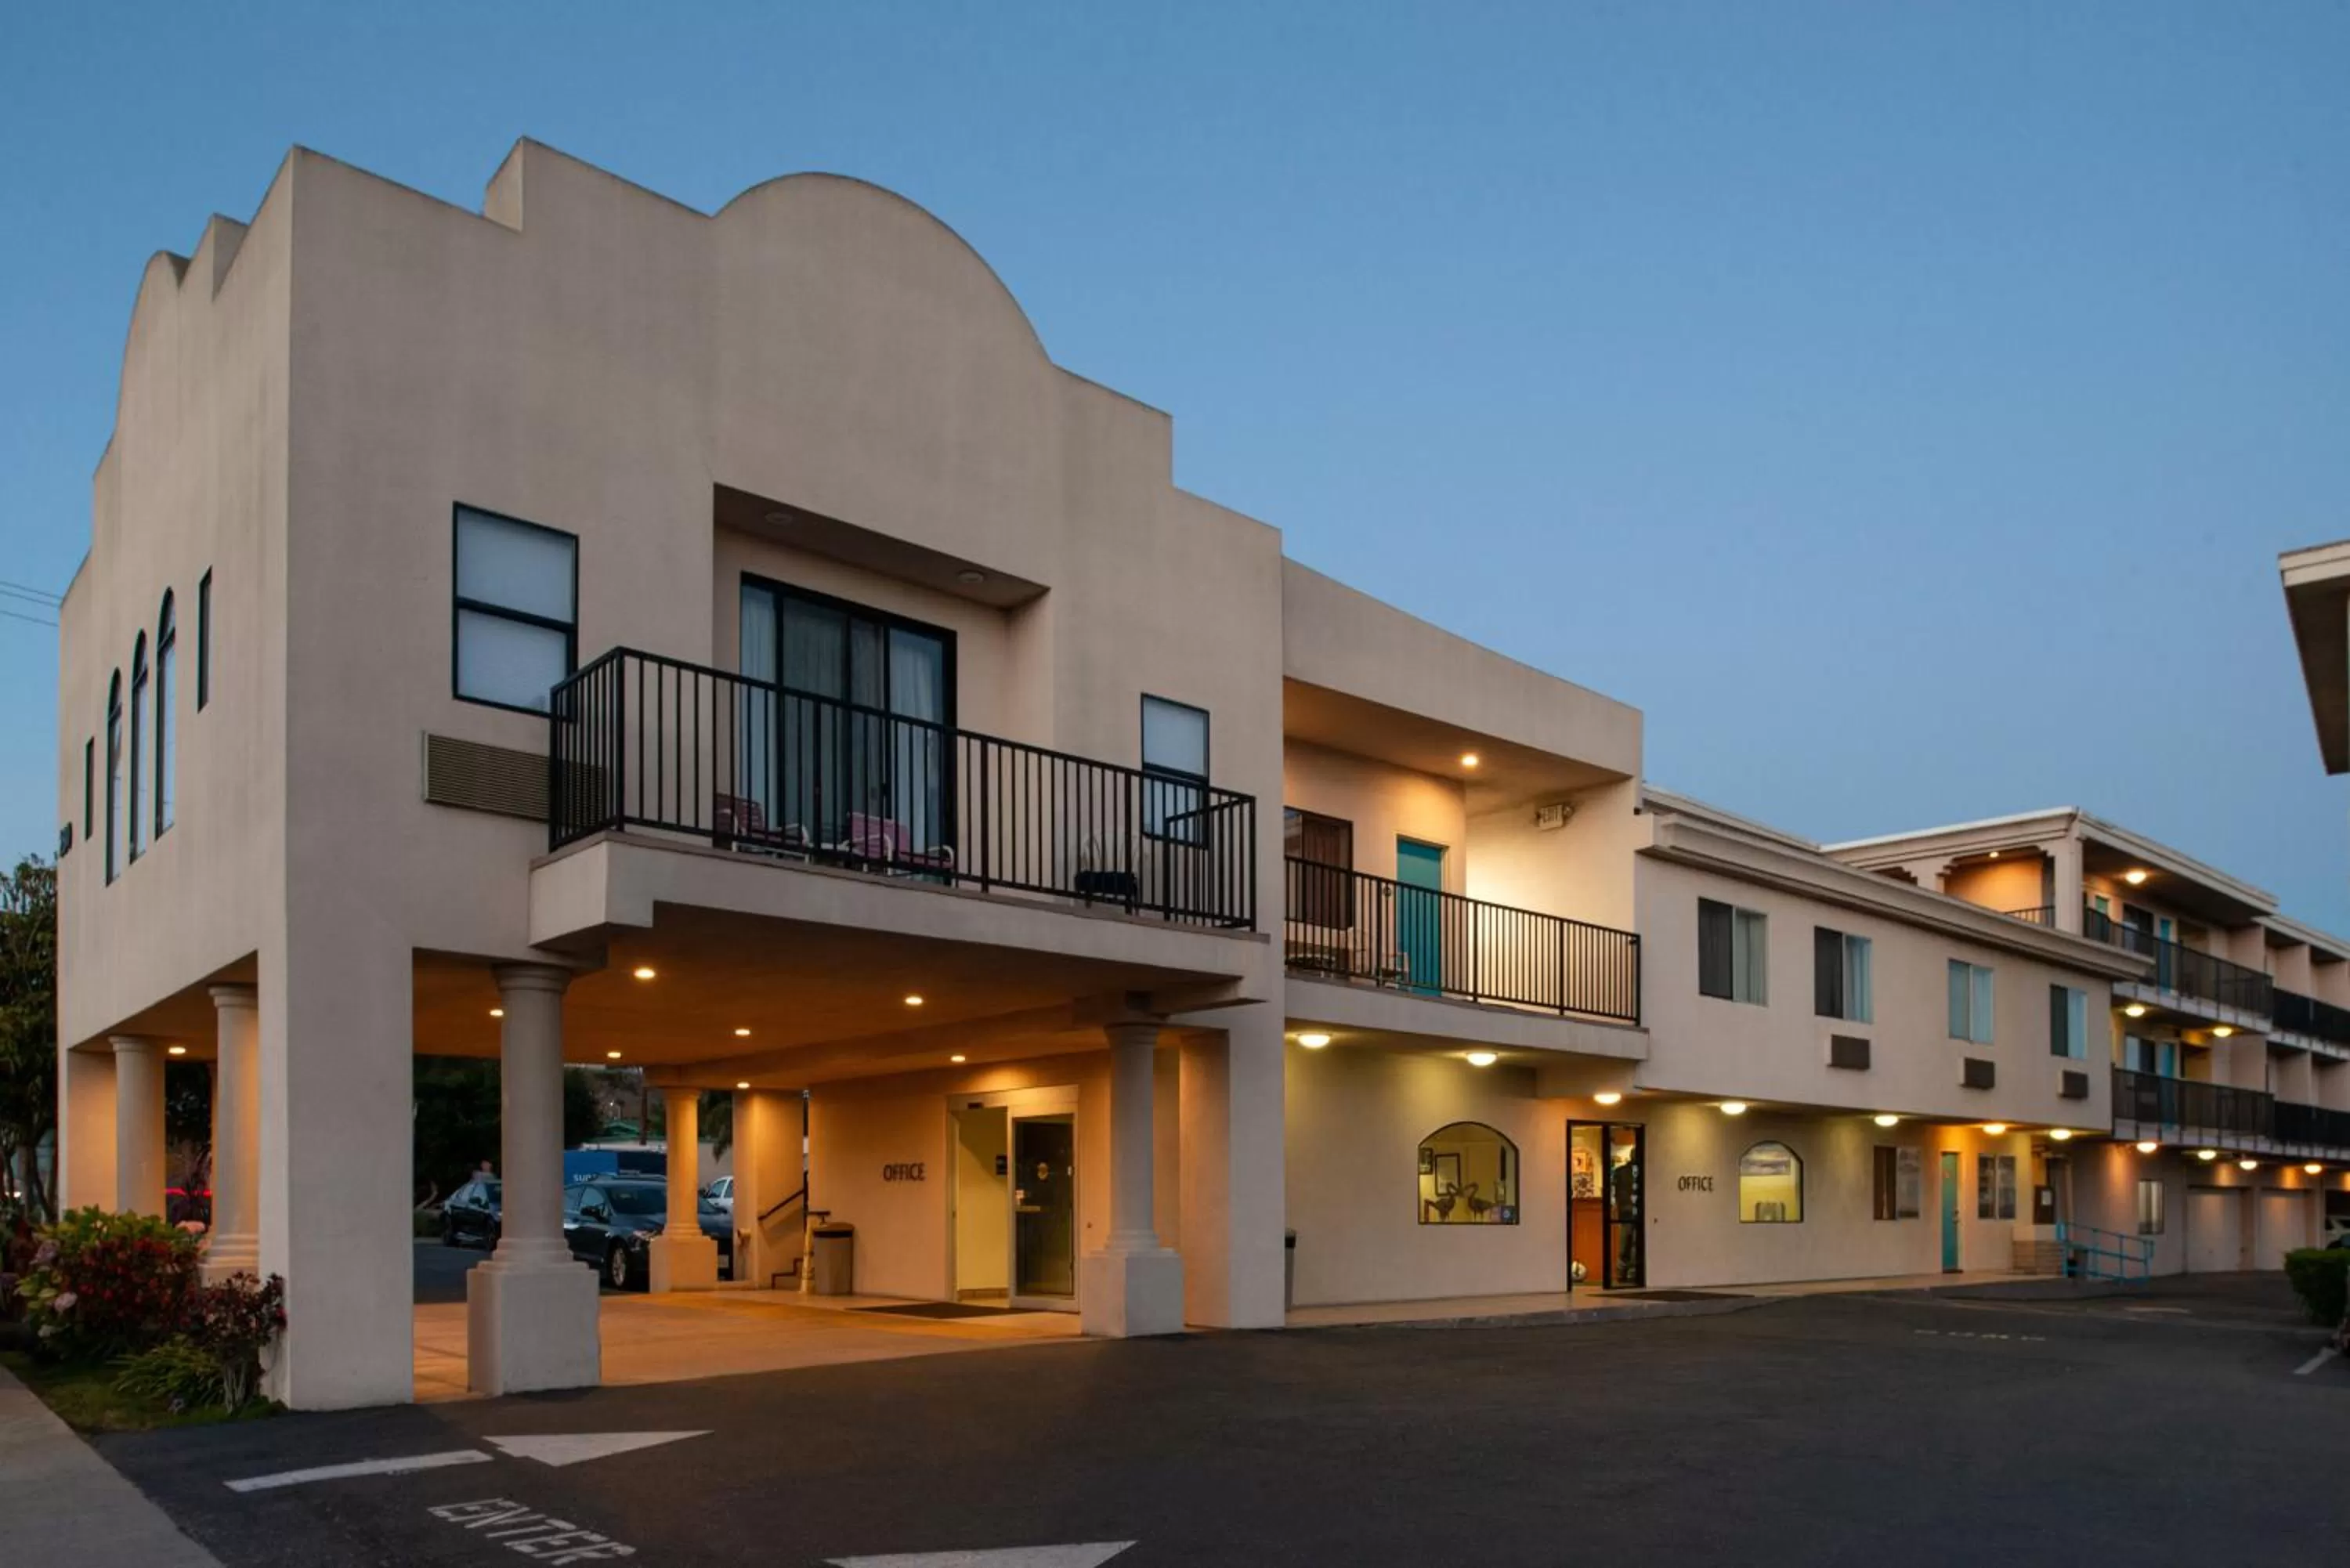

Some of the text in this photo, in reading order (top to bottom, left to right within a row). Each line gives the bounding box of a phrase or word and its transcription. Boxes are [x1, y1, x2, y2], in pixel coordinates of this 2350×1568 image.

[883, 1162, 926, 1182] OFFICE
[1677, 1176, 1714, 1193] OFFICE
[427, 1498, 636, 1566] ENTER
